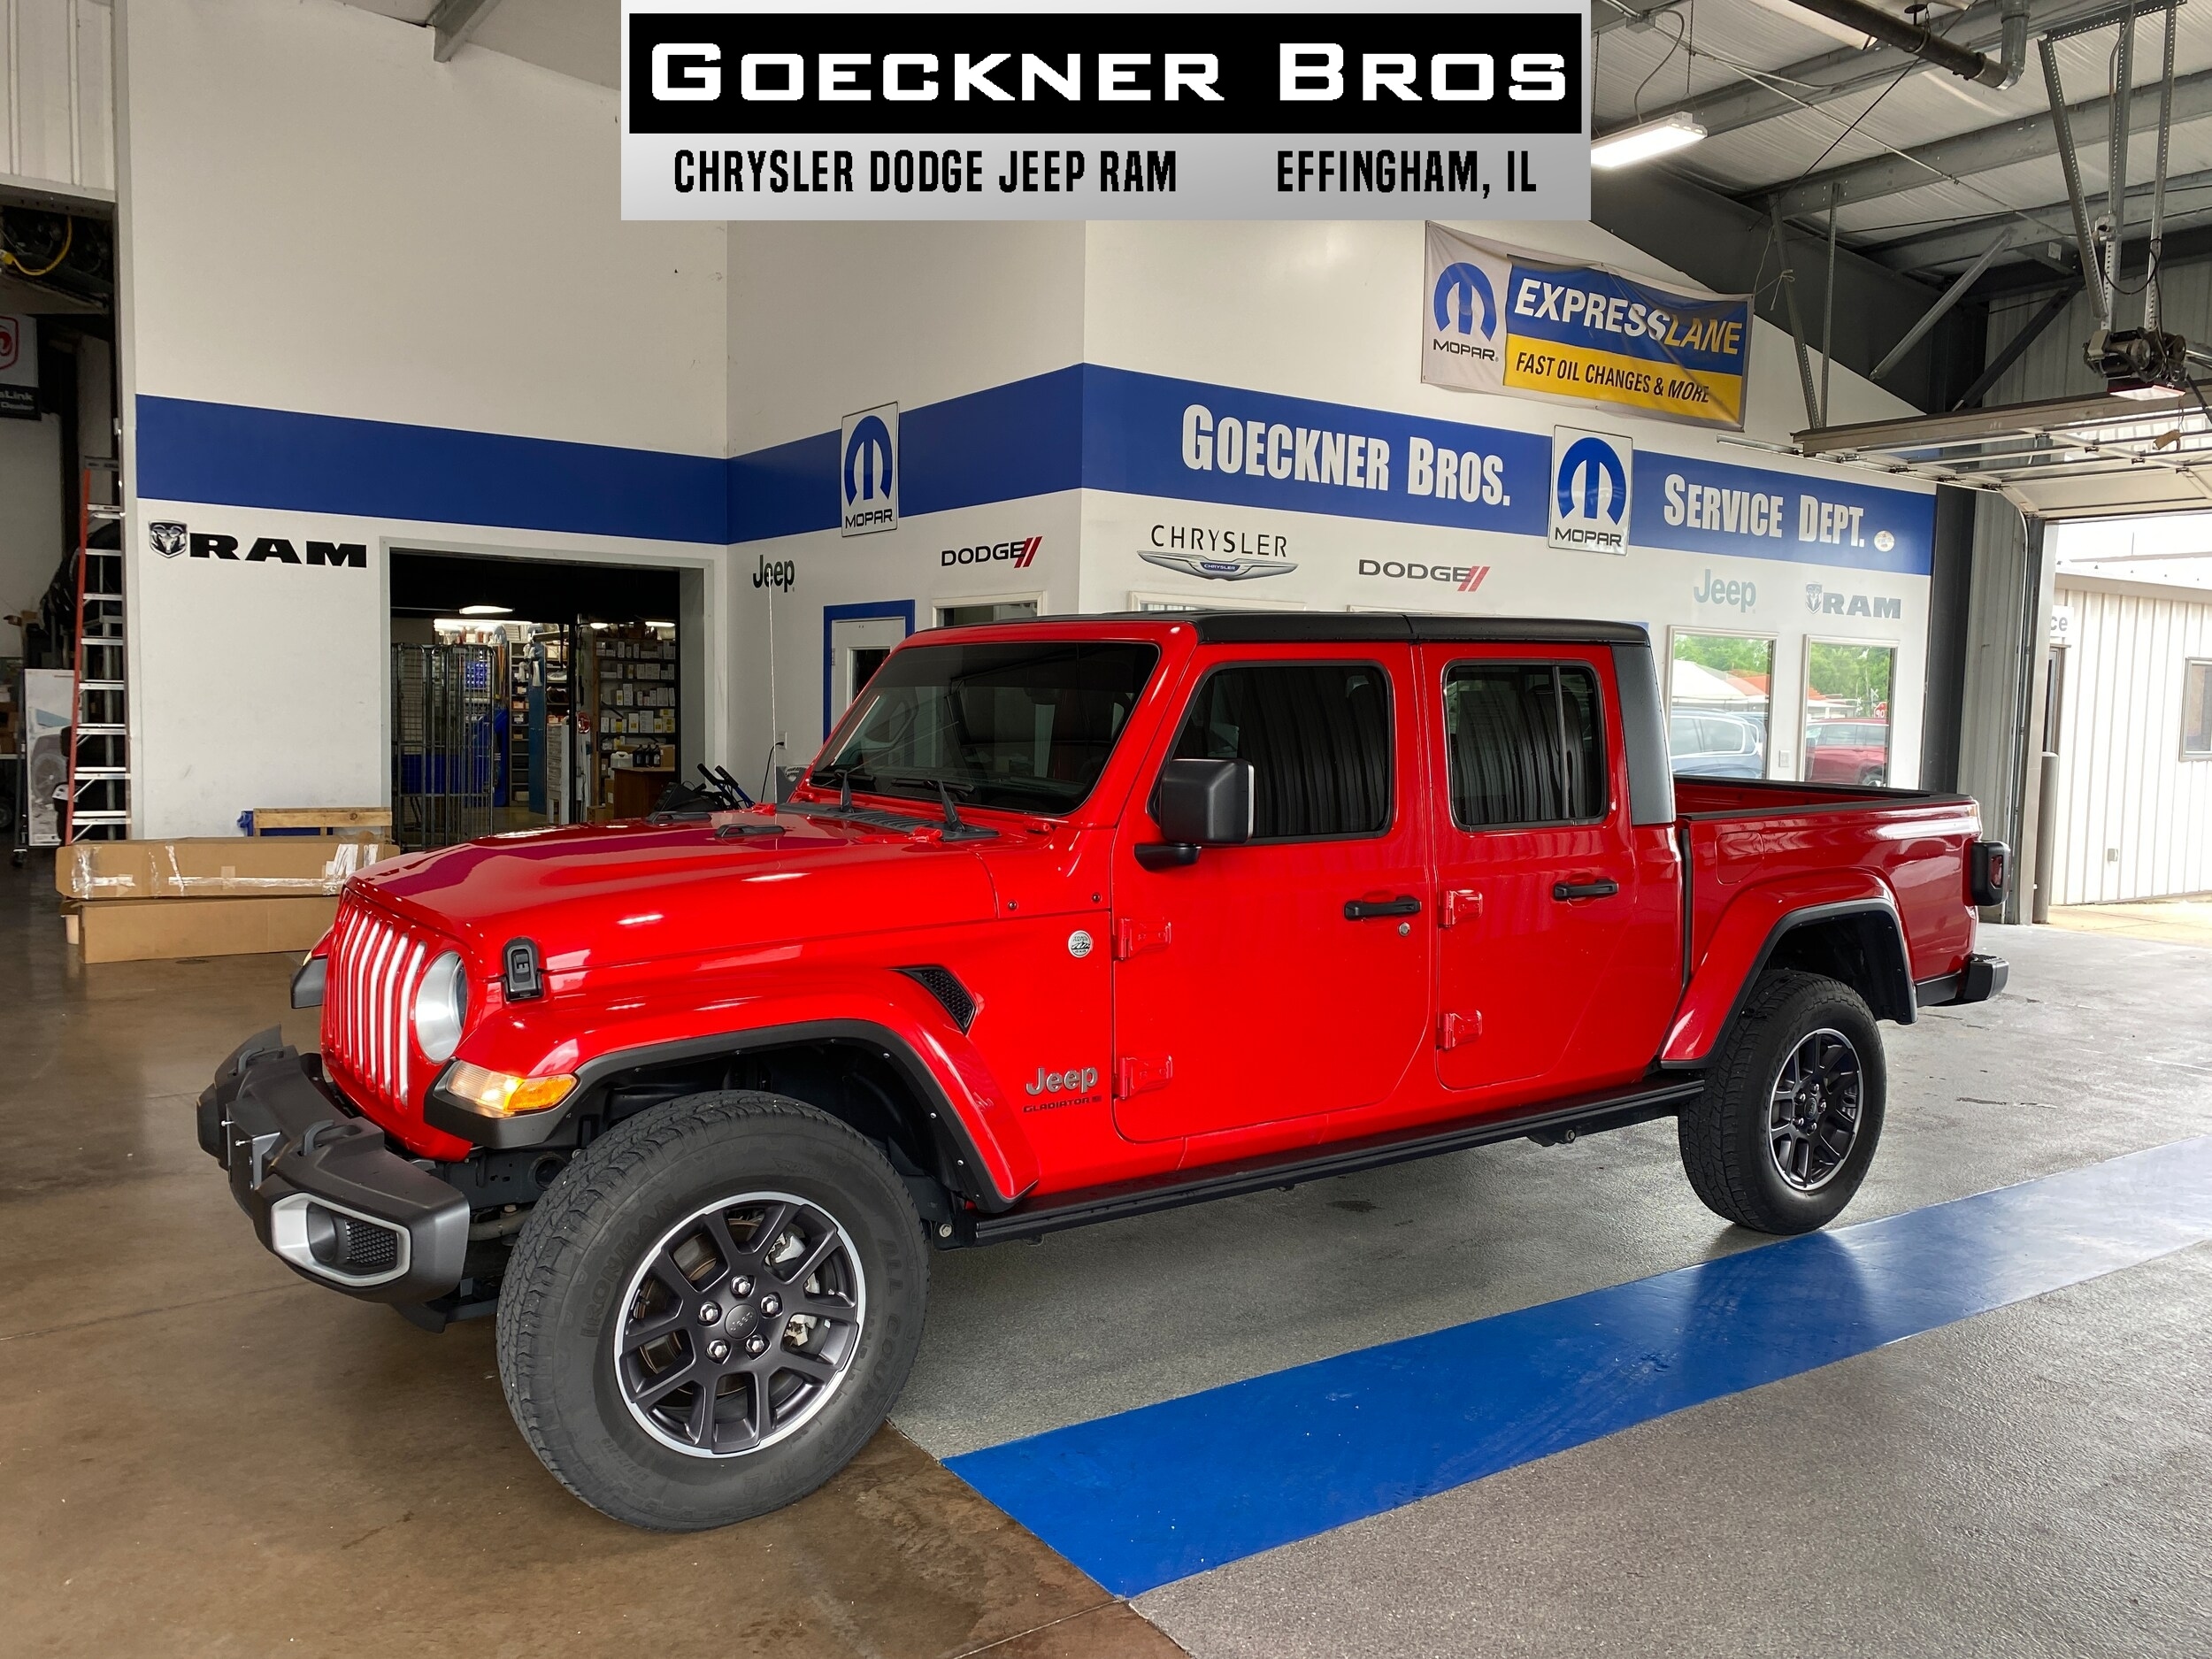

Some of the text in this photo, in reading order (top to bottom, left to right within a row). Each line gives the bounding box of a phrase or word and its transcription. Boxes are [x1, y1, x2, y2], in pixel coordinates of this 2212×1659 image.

[1432, 338, 1496, 362] MOPAR
[1516, 350, 1711, 403] FAST OIL CHANGES & MORE
[1180, 403, 1391, 492] GOECKNER
[844, 508, 894, 530] MOPAR
[1663, 473, 1784, 539] SERVICE
[188, 531, 368, 569] RAM
[1150, 524, 1288, 558] CHRYSLER
[1554, 526, 1623, 548] MOPAR
[941, 541, 1026, 567] DODGE
[752, 554, 795, 593] Jeep
[1358, 558, 1471, 583] DODGE
[1694, 568, 1757, 613] Jeep
[1822, 592, 1901, 619] RAM
[1025, 1066, 1099, 1096] Jeep
[1023, 1097, 1090, 1113] GLADIATOR
